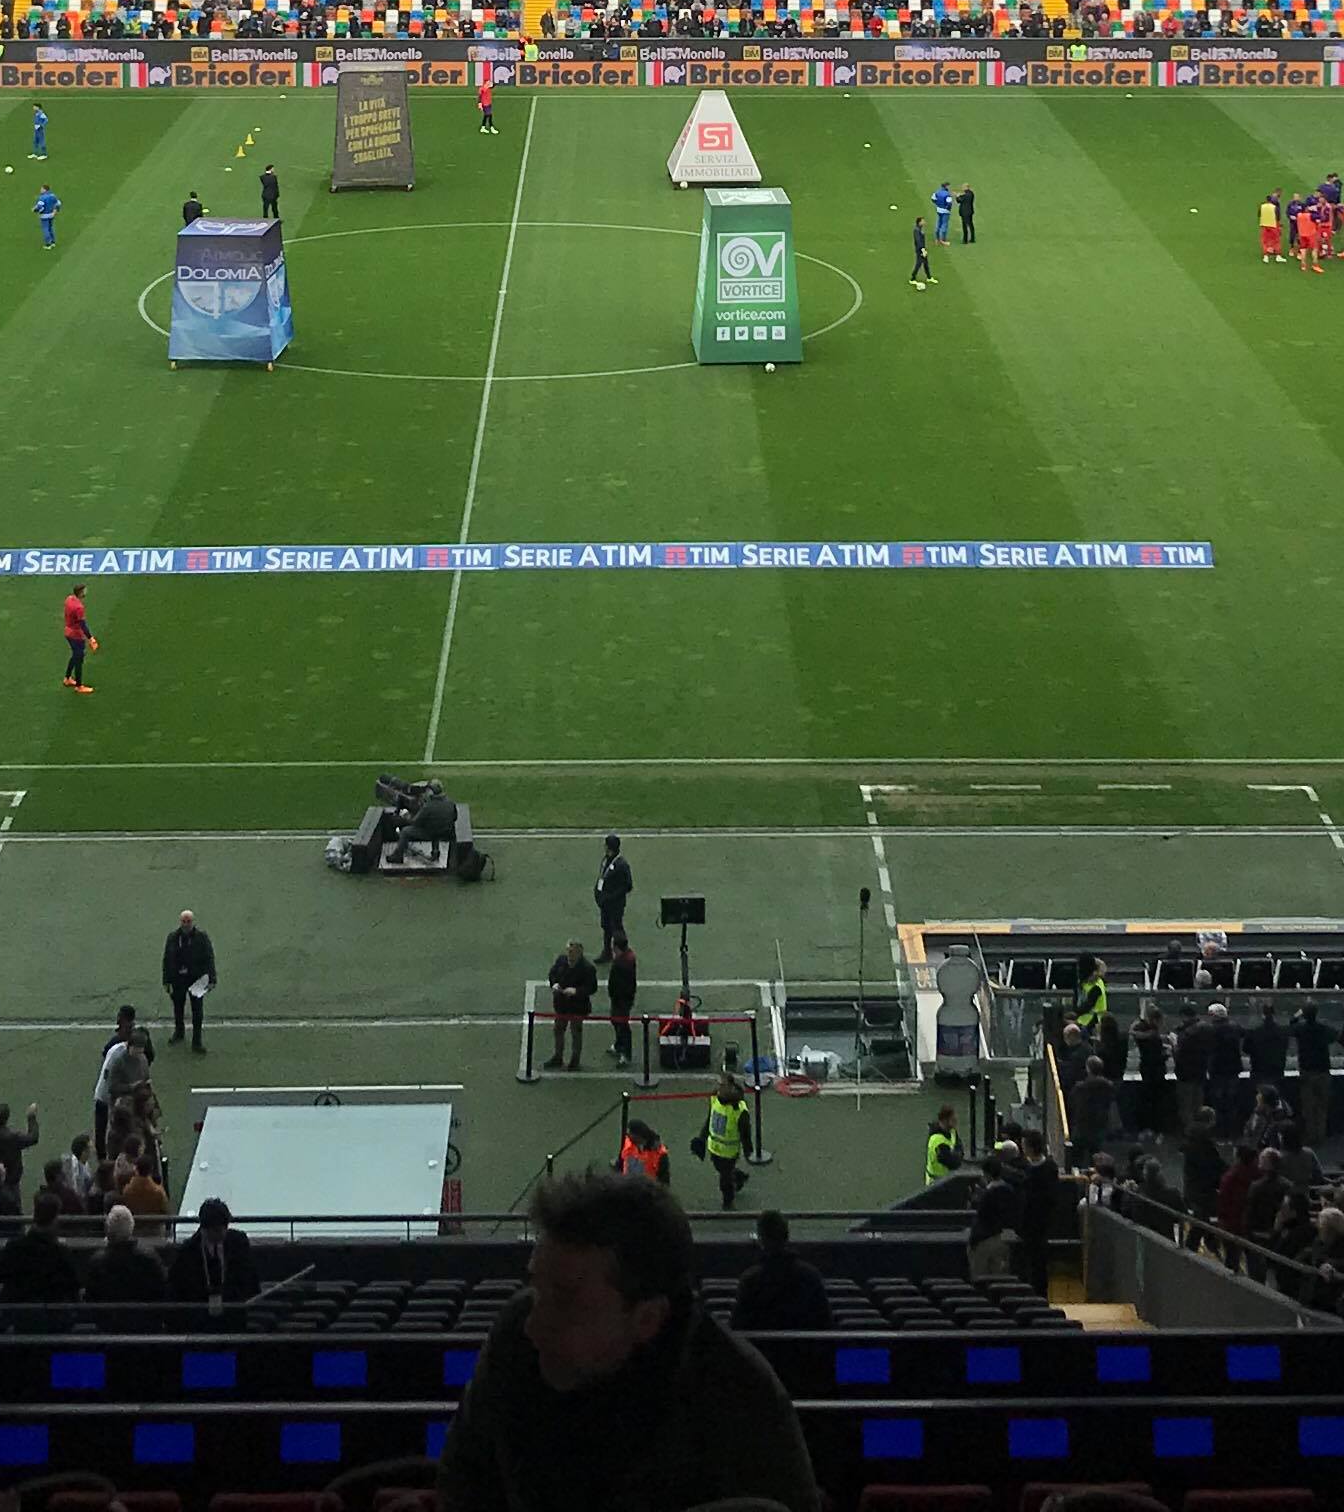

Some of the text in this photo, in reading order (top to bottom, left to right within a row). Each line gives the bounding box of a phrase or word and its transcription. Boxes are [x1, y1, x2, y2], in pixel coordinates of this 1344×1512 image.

[1, 64, 117, 86] Bricofer
[175, 63, 291, 85] Bricofer
[519, 62, 635, 84] Bricofer
[690, 61, 803, 83] Bricofer
[860, 62, 974, 84] Bricofer
[1031, 62, 1146, 84] Bricofer
[1207, 62, 1318, 84] Bricofer
[695, 155, 738, 164] SERVIZI
[680, 168, 753, 177] IMMOBILIARI
[177, 265, 262, 280] DOLOMIA
[723, 284, 780, 297] VORTICE
[716, 308, 786, 321] vortice.com
[212, 551, 253, 568] TIM
[451, 548, 492, 566] TIM
[689, 547, 730, 564] TIM
[926, 547, 967, 564] TIM
[1163, 547, 1205, 564] TIM
